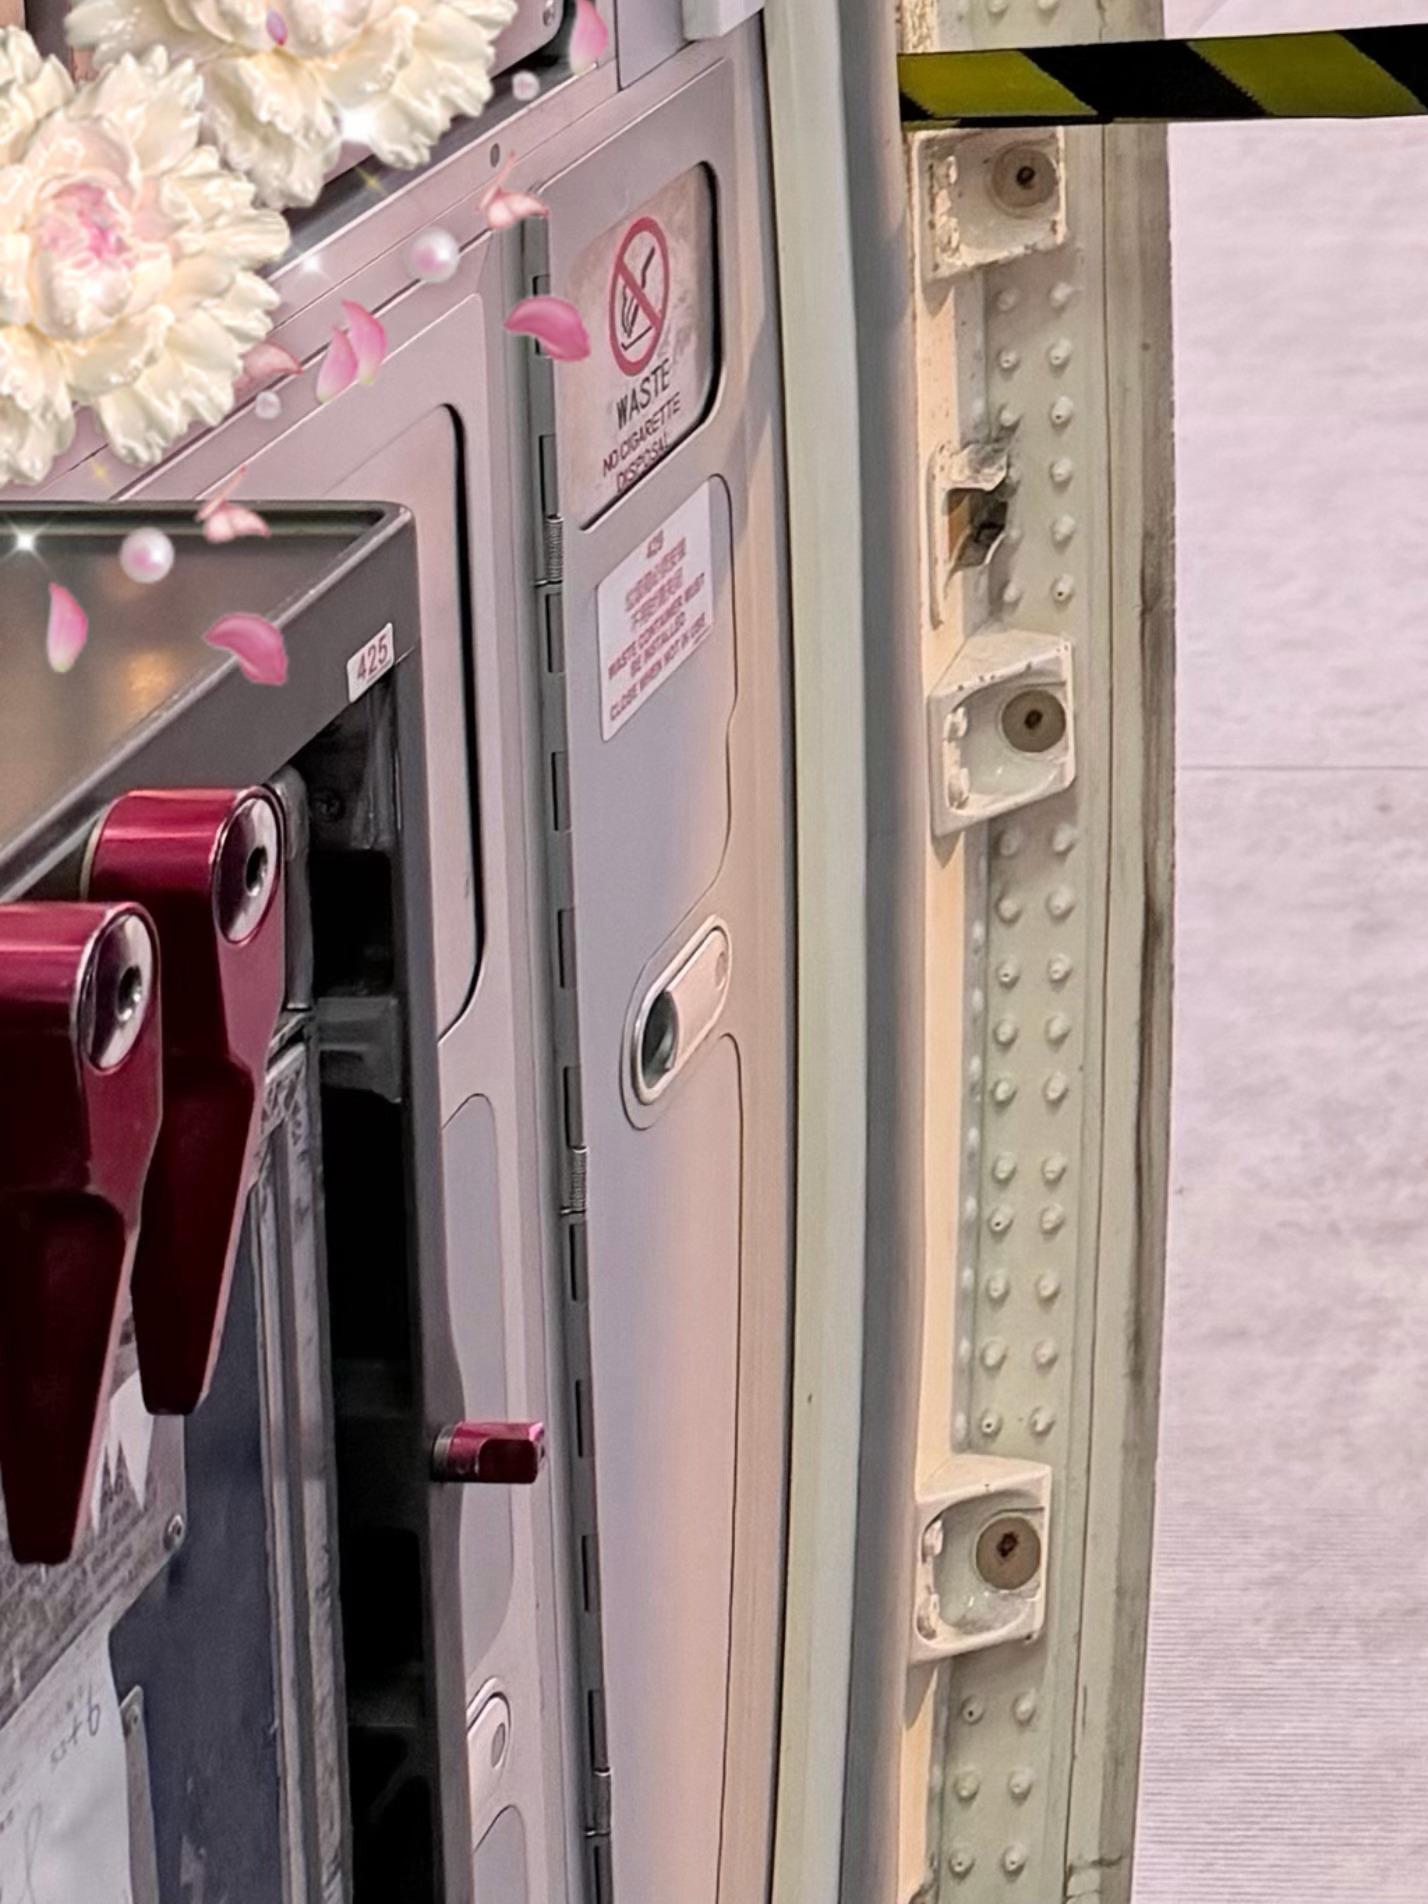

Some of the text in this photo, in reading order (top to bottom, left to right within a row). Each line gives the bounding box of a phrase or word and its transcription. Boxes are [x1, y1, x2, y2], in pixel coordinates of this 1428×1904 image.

[616, 357, 670, 430] WASTE
[603, 391, 681, 478] NO CIGARETTE
[357, 633, 388, 680] 425
[607, 639, 637, 681] WASTE
[637, 594, 684, 650] CONTAINER
[643, 611, 686, 665] INSTALLED
[609, 681, 638, 722] CLOSE
